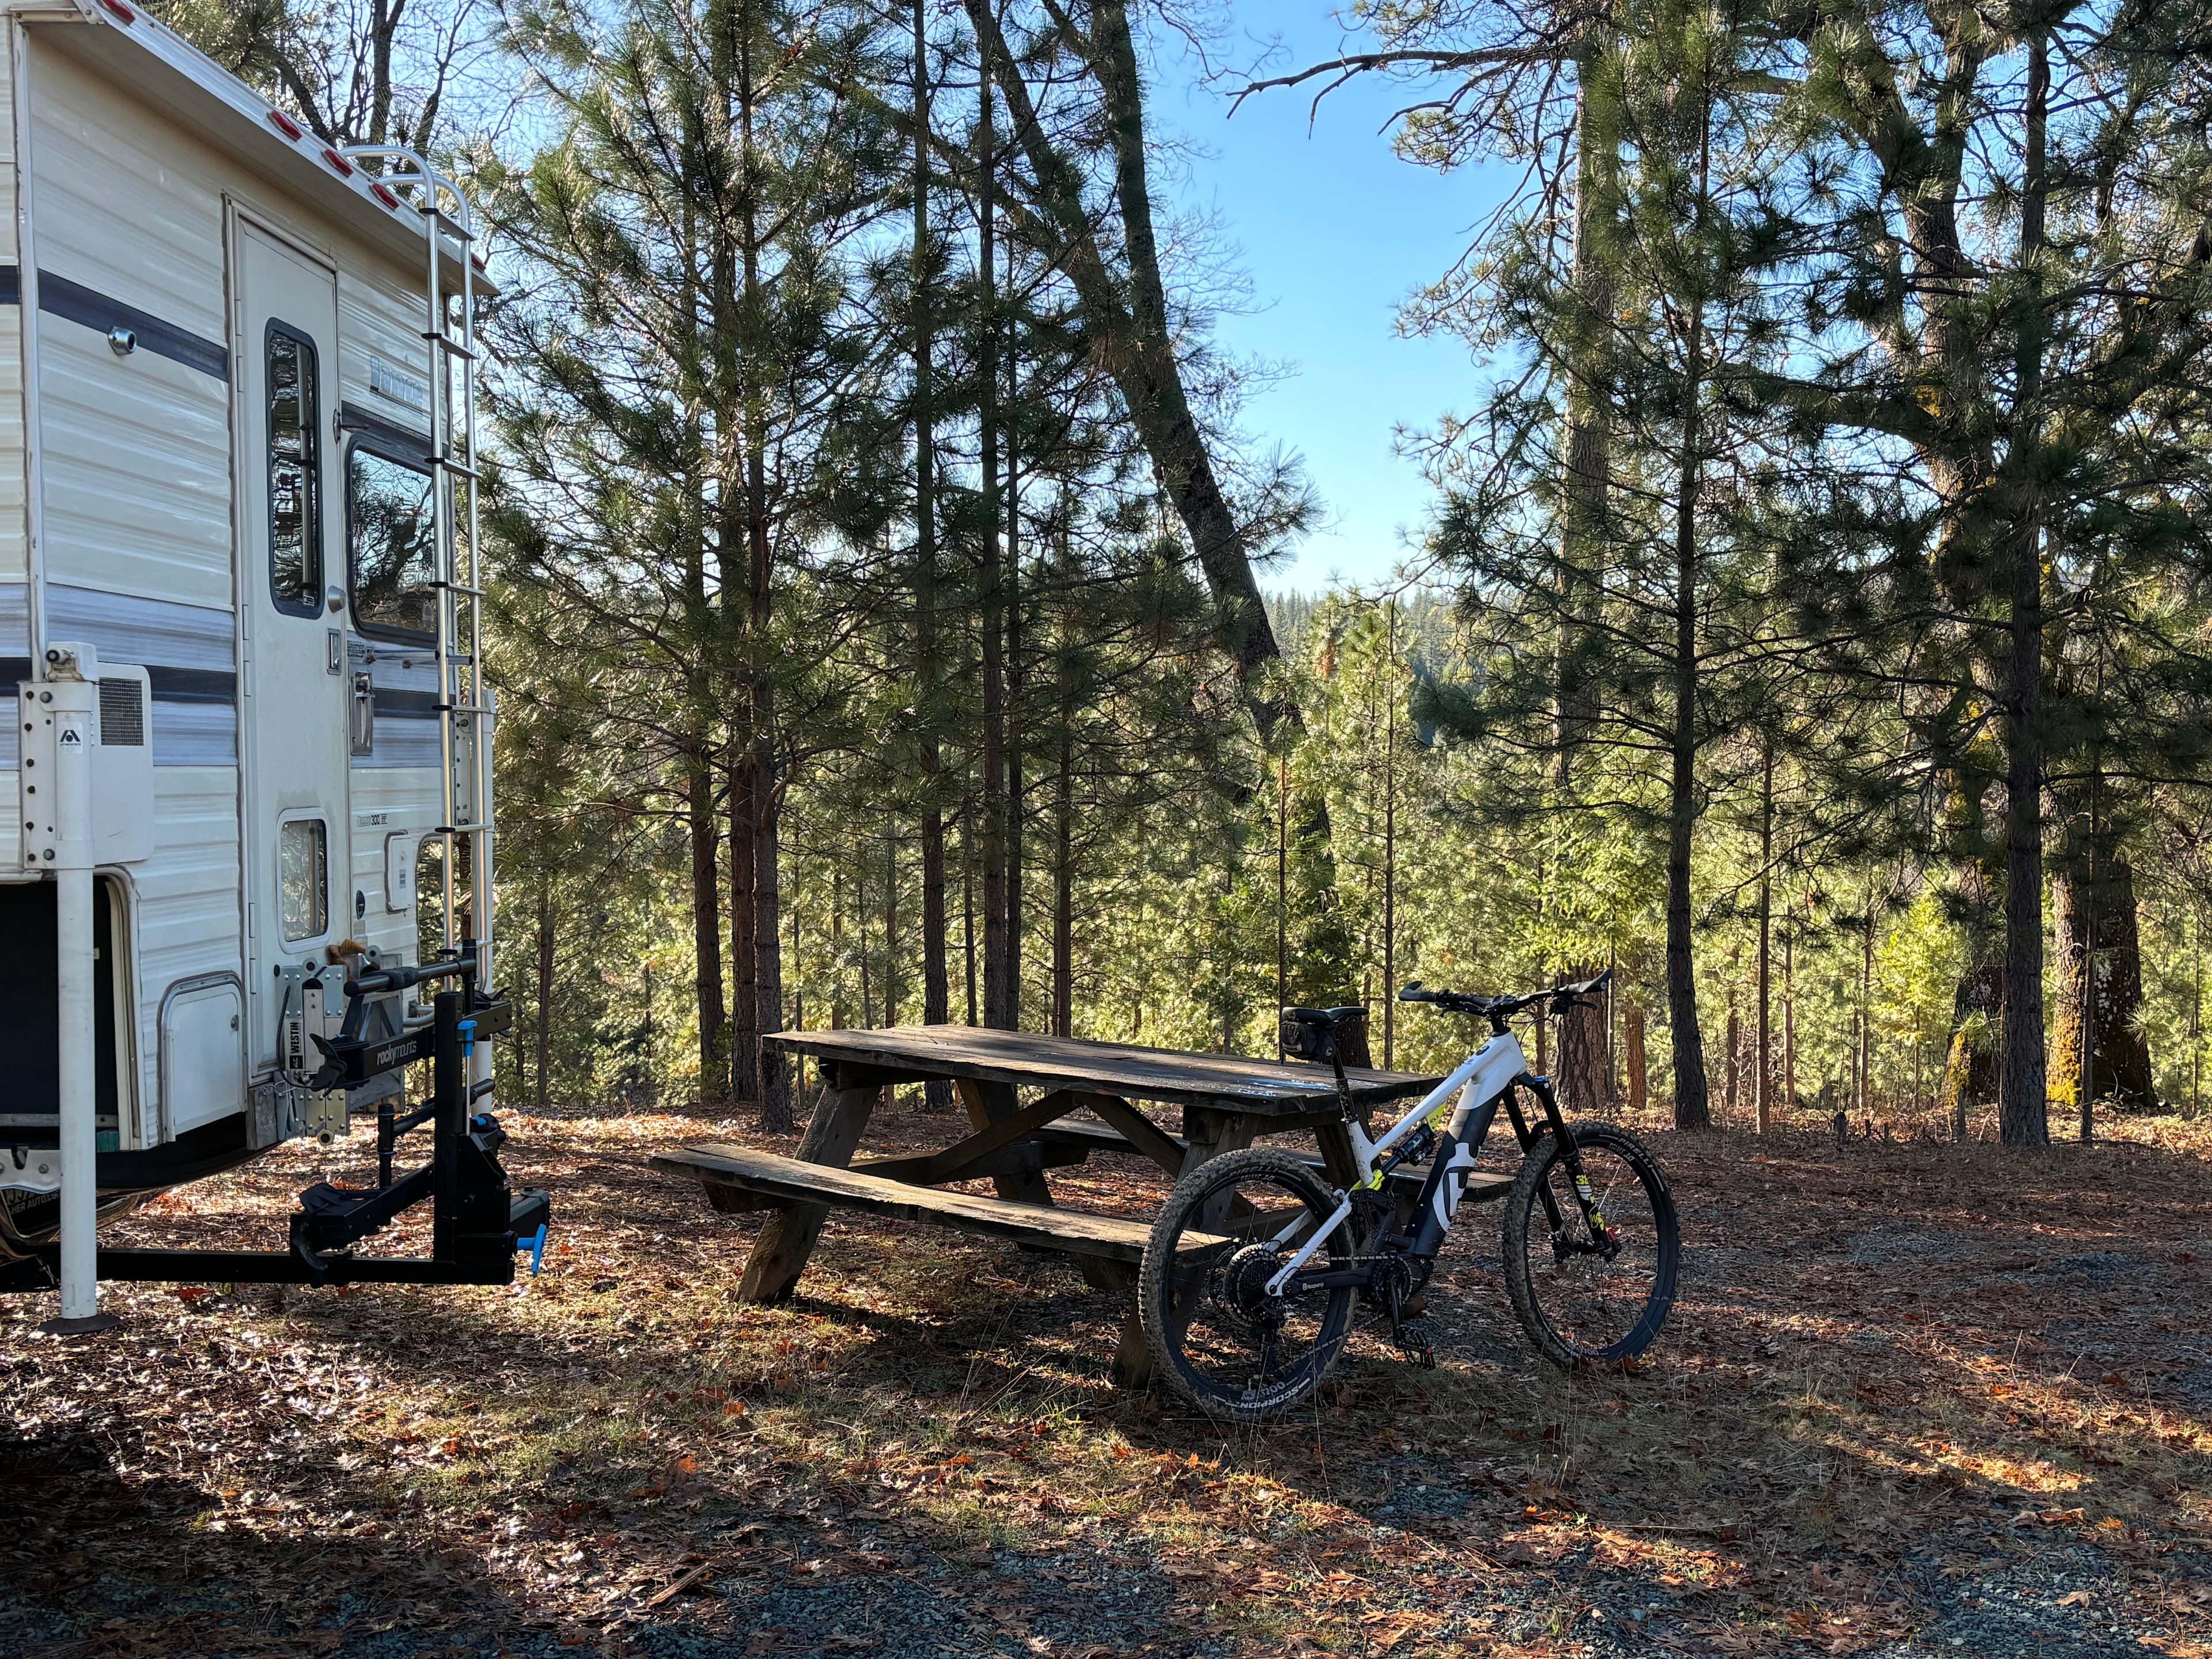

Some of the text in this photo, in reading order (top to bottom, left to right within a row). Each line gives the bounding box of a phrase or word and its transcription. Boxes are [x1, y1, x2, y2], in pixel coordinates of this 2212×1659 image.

[290, 1022, 300, 1054] WESTIN
[377, 1039, 417, 1066] rockymounts
[1618, 1138, 1653, 1168] PIRELLI
[1229, 1166, 1278, 1179] PIRELLI
[1240, 1385, 1299, 1408] SCORPION
